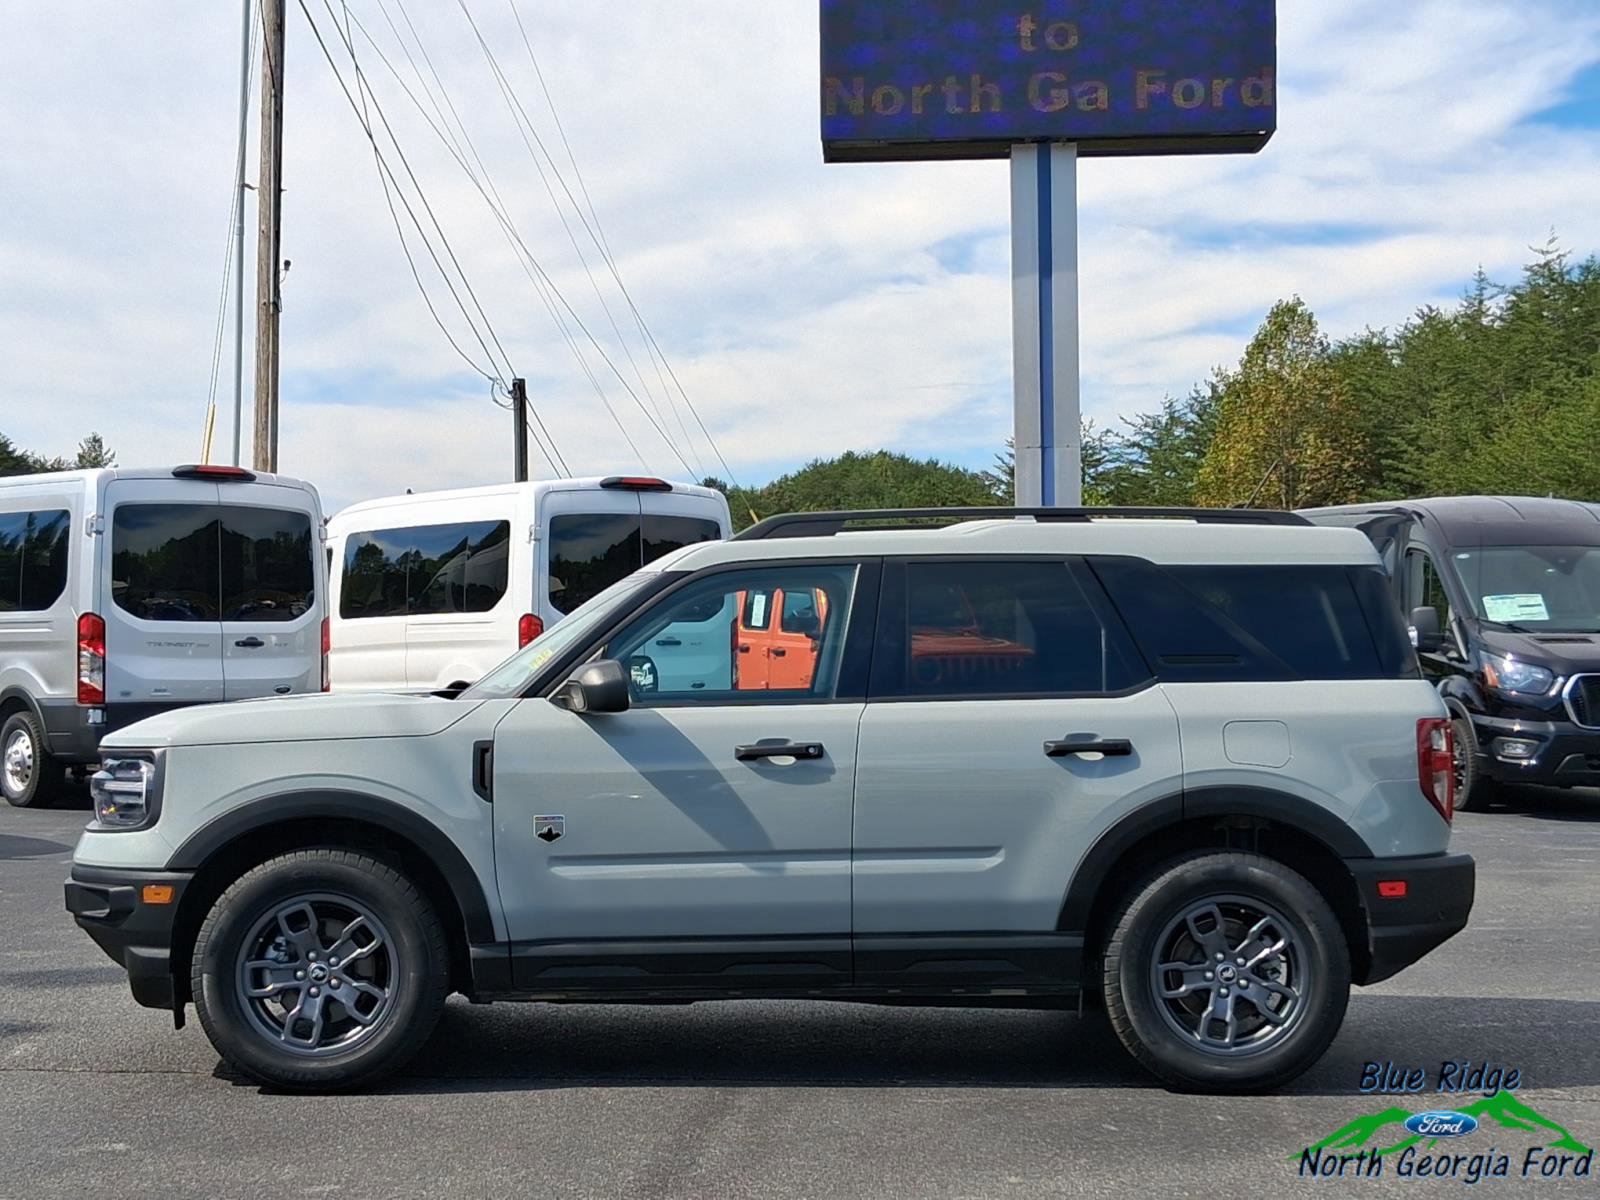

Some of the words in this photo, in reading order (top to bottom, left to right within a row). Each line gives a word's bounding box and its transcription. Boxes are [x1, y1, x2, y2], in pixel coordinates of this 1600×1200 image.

[1016, 14, 1079, 52] to
[823, 74, 1001, 116] North
[1027, 71, 1110, 113] Ga
[1135, 67, 1274, 109] Ford
